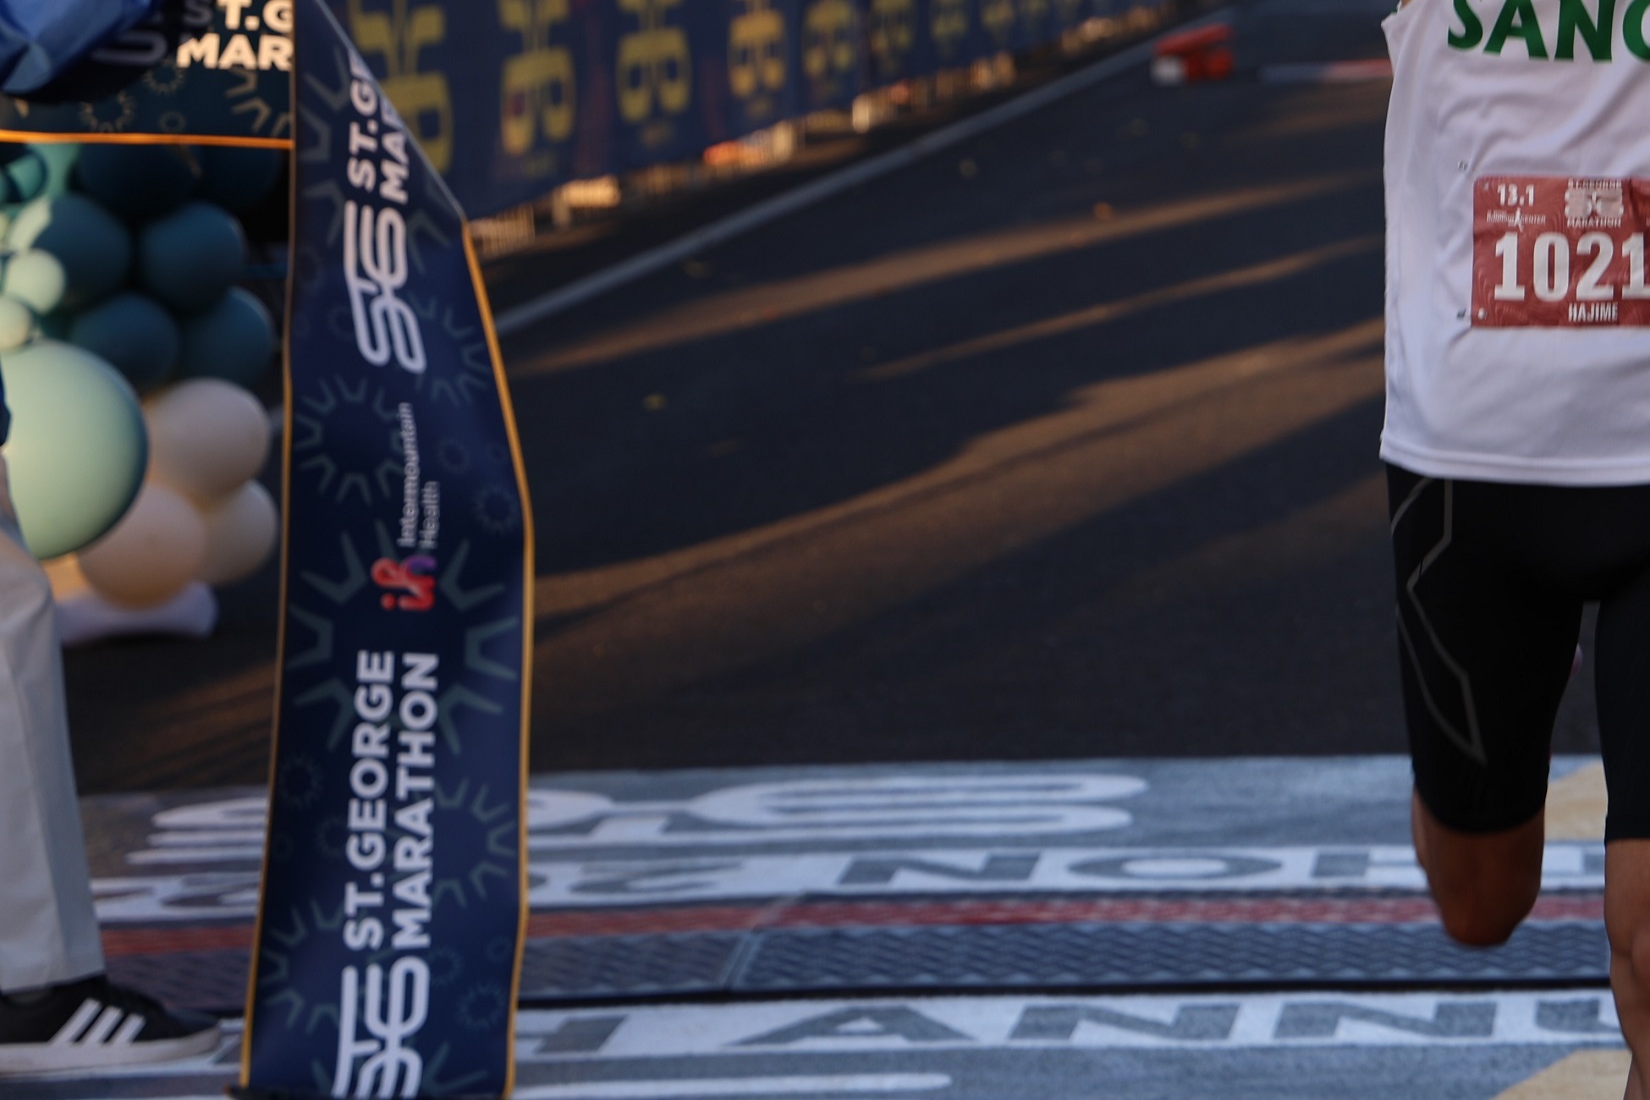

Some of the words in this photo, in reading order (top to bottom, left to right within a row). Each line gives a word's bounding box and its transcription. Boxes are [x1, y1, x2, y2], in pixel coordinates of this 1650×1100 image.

[1496, 183, 1535, 207] 13.1
[1566, 217, 1622, 229] MARATHON
[1568, 302, 1619, 322] HAJIME
[397, 403, 415, 547] Intermountain
[419, 481, 440, 549] Health
[343, 651, 396, 950] ST.GEORGE
[391, 652, 439, 948] MARATHON
